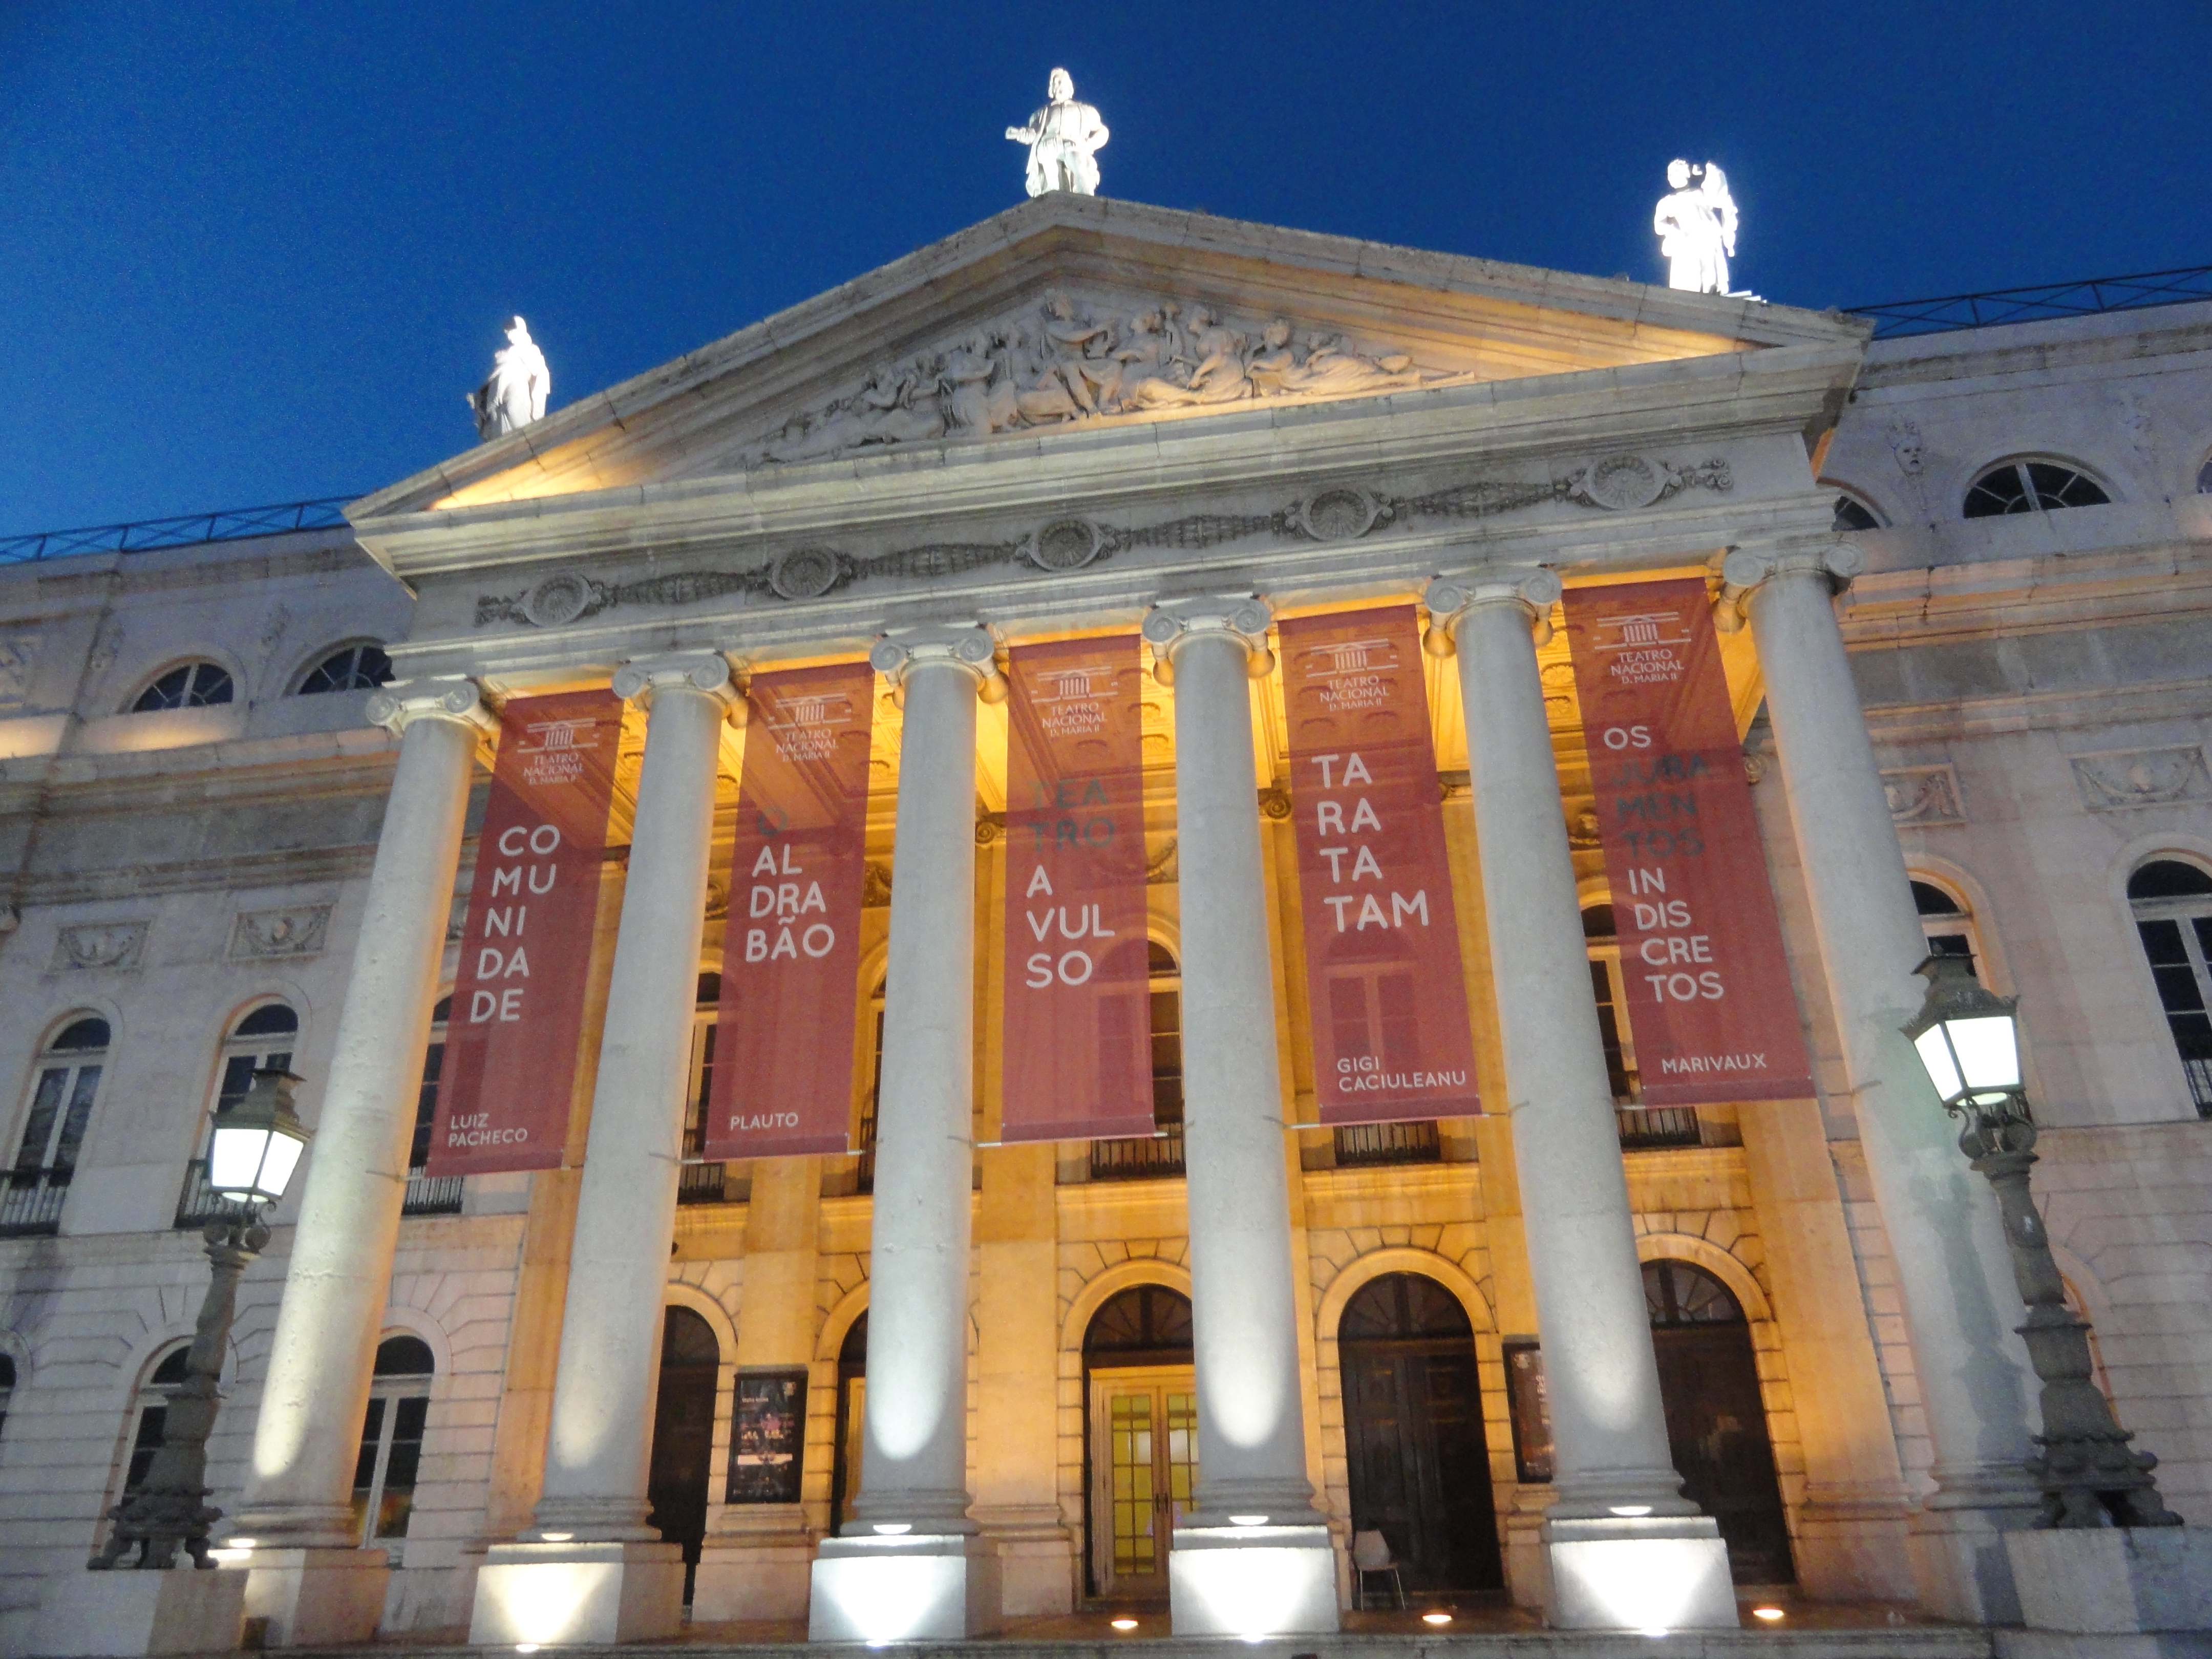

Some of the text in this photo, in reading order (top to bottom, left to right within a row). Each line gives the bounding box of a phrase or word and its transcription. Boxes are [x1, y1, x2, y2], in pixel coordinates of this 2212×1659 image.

[1611, 660, 1684, 676] NACIONAL
[1618, 649, 1672, 663] TEATRO
[1328, 675, 1378, 689] TEATRO
[1634, 673, 1669, 683] MARIA
[1052, 703, 1098, 716] TEATRO
[1320, 686, 1389, 703] NACIONAL
[1043, 712, 1107, 728] NACIONAL
[1604, 726, 1651, 750] OS
[1312, 753, 1372, 788] TA
[1611, 754, 1712, 787] JURA
[1027, 777, 1108, 811] TEA
[1617, 791, 1697, 823] MEN
[1317, 797, 1381, 836] RA
[499, 824, 560, 857] CO
[1026, 817, 1114, 852] TRO
[1620, 826, 1705, 858] TOS
[753, 844, 802, 878] AL
[1320, 845, 1382, 884] TA
[492, 864, 557, 898] MU
[1026, 864, 1053, 898] A
[1628, 867, 1665, 895] IN
[750, 881, 826, 918] DRA
[1324, 890, 1430, 933] TAM
[1634, 900, 1691, 930] DIS
[484, 906, 526, 938] NI
[1026, 904, 1115, 942] VUL
[746, 915, 835, 963] BÃO
[1641, 936, 1713, 966] CRE
[477, 947, 530, 980] DA
[1026, 950, 1093, 988] SO
[1645, 972, 1724, 1003] TOS
[470, 989, 524, 1024] DE
[1337, 1058, 1380, 1074] GIGI
[1662, 1053, 1767, 1074] MARIVAUX
[1338, 1071, 1466, 1093] CACIULEANU
[451, 1113, 489, 1130] LUIZ
[730, 1112, 798, 1130] PLAUTO
[449, 1128, 527, 1147] PACHECO
